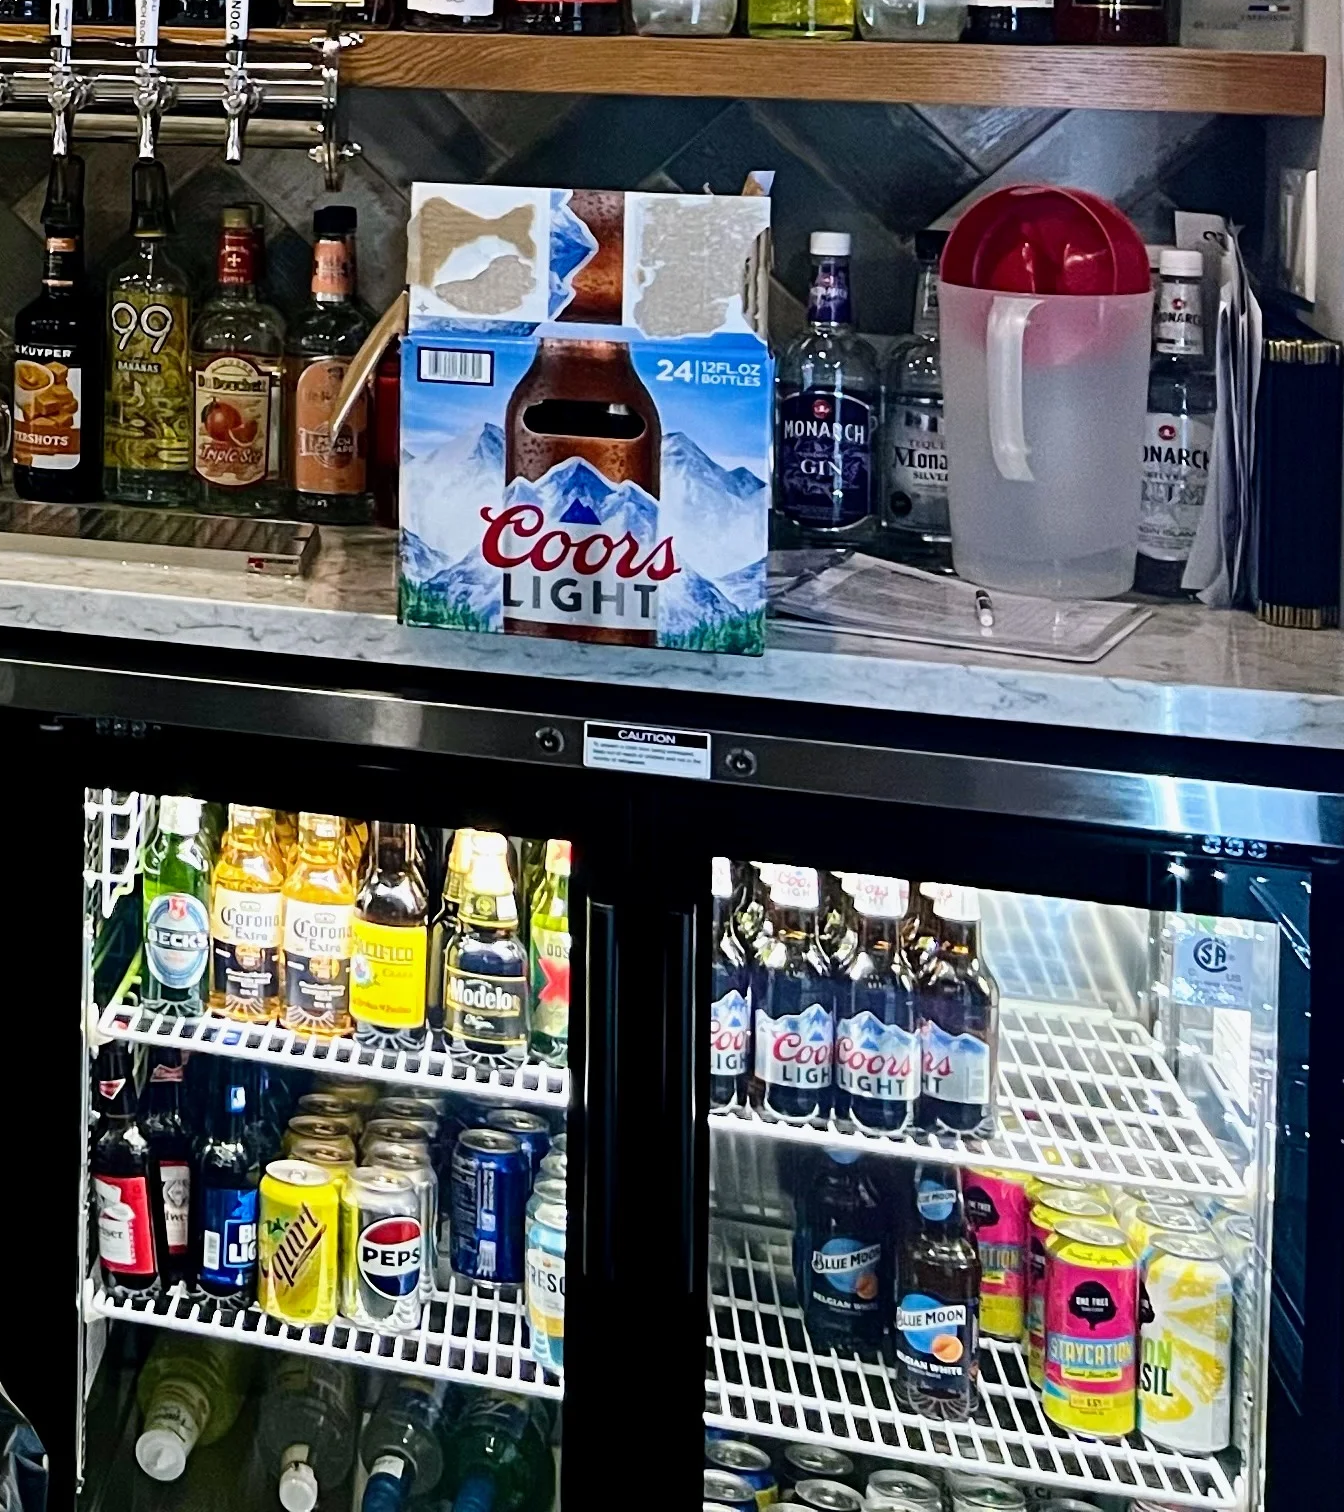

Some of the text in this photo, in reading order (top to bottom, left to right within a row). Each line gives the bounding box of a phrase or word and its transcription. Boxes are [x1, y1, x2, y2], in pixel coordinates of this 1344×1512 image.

[112, 301, 173, 354] 99
[21, 346, 72, 359] KUYPER
[118, 361, 160, 373] BANANAS
[655, 360, 693, 382] 24
[701, 375, 761, 387] BOTTLES
[784, 420, 865, 445] MONARCH
[201, 443, 237, 464] Triple
[800, 459, 843, 476] GIN
[480, 504, 681, 581] Coors
[503, 573, 657, 619] LIGHT
[618, 730, 676, 745] CAUTION
[221, 906, 280, 929] Corona
[148, 929, 208, 948] BECK'S
[235, 927, 269, 942] Extra
[294, 916, 353, 941] Corona
[309, 938, 342, 954] Extra
[450, 977, 514, 1010] Modelo
[837, 1036, 911, 1077] Coors
[841, 1071, 906, 1095] LIGHT
[813, 1245, 880, 1270] BLUE MOON
[813, 1291, 852, 1309] BELGIAN
[926, 1310, 964, 1326] MOON
[1049, 1342, 1132, 1367] STAYCATION
[930, 1363, 963, 1376] WHITE
